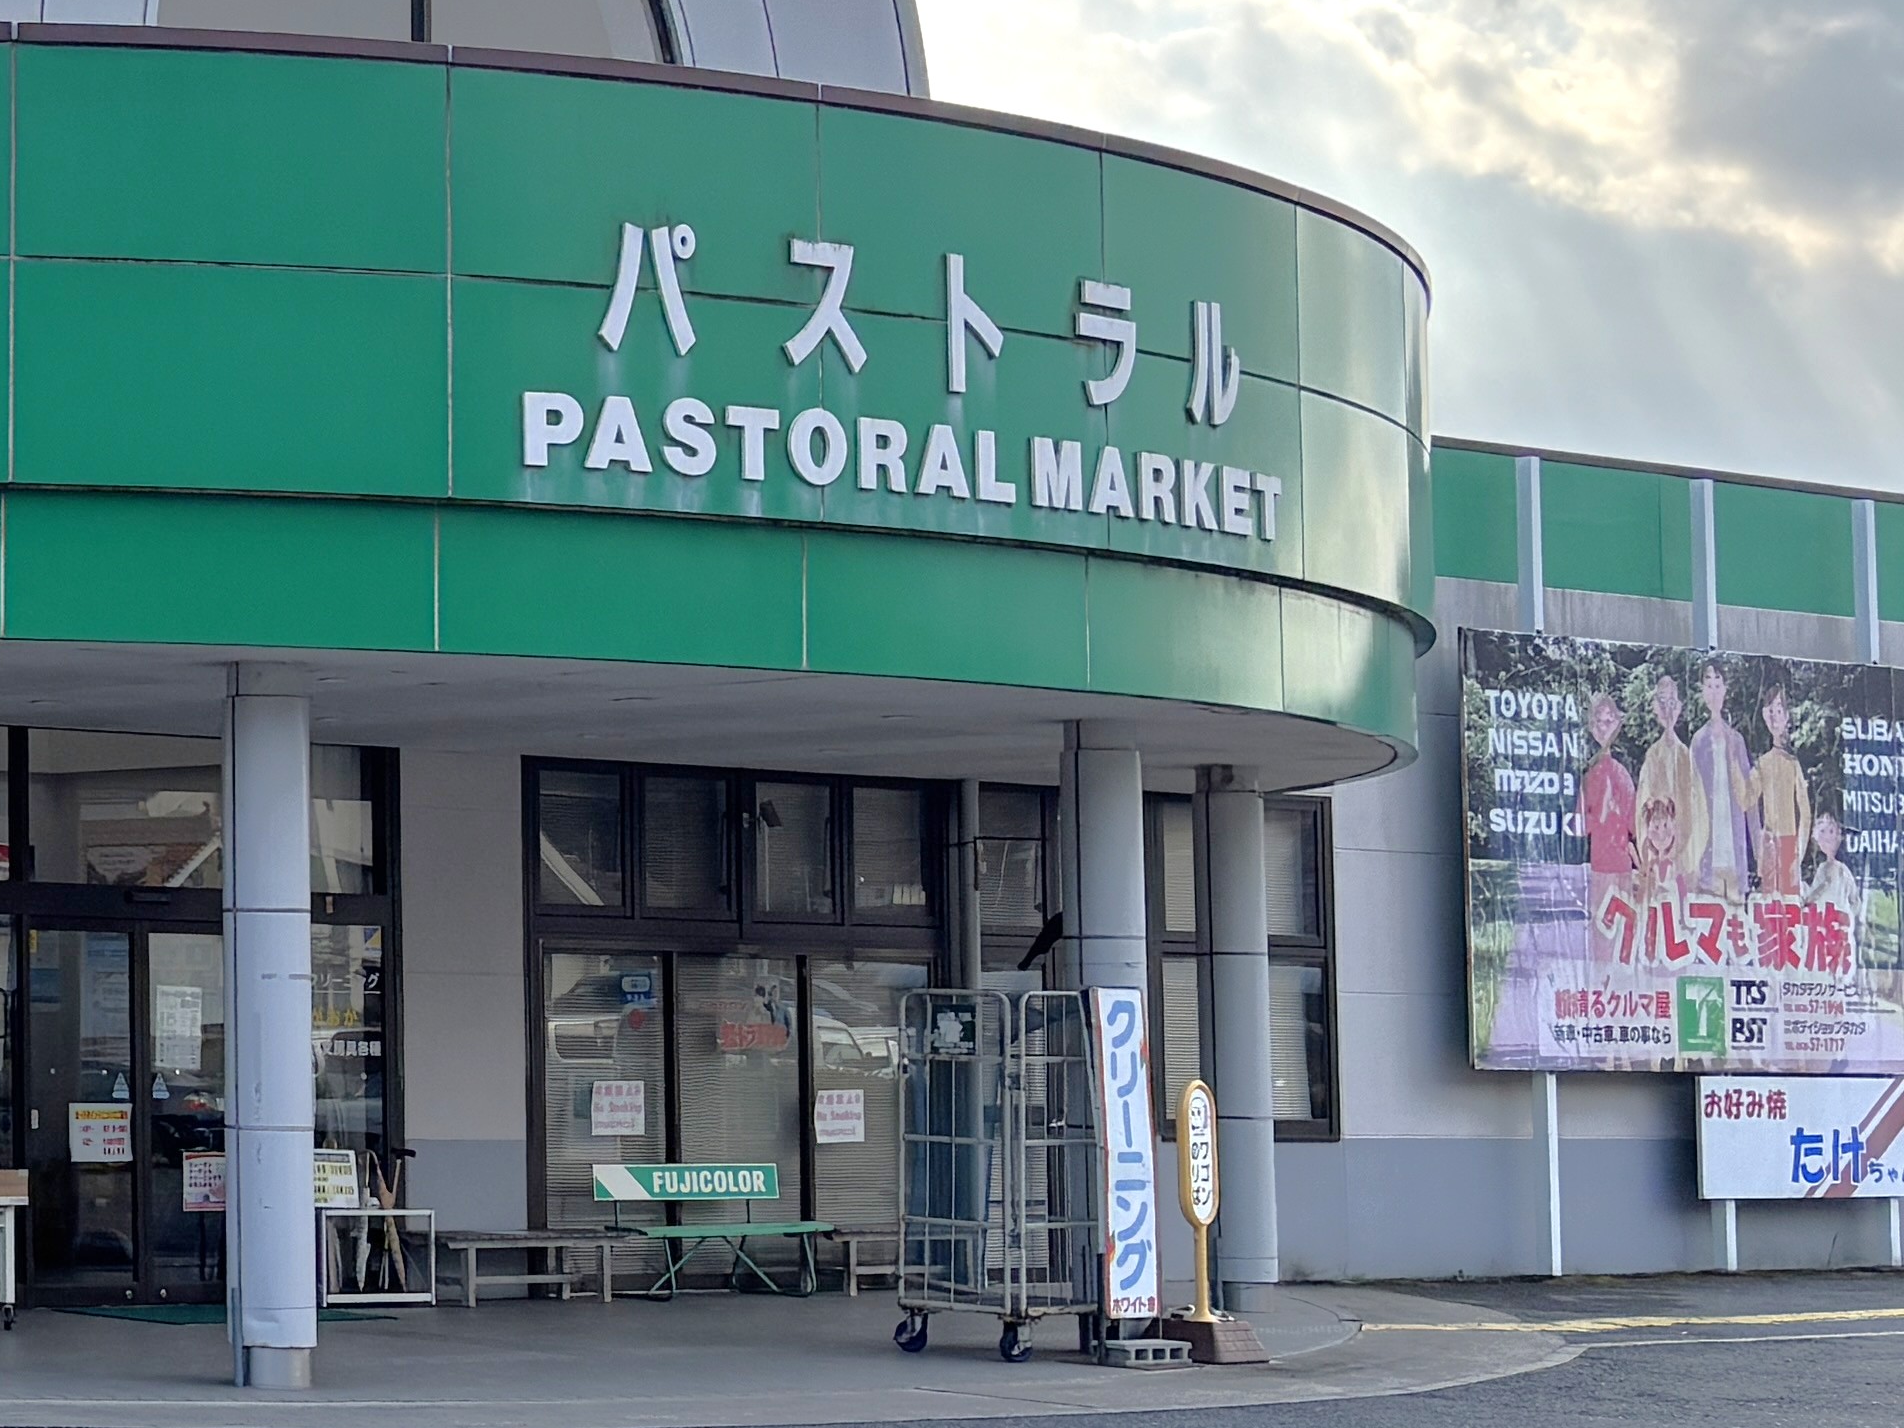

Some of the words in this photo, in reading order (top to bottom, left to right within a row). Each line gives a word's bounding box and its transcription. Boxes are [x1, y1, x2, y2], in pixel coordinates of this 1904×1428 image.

[597, 222, 1240, 426] パストラル
[522, 390, 1016, 504] PASTORAL
[1030, 435, 1282, 541] MARKET
[1486, 689, 1578, 721] TOYOTA
[1489, 728, 1579, 758] NISSAN
[1490, 808, 1583, 837] SUZUKI
[1601, 895, 1854, 974] クルマも家族
[1730, 980, 1769, 1005] TTS
[1732, 1018, 1768, 1043] BST
[1704, 1088, 1787, 1120] お好み焼
[1105, 1000, 1152, 1290] クリーニング
[1790, 1126, 1904, 1184] たけちゃ
[652, 1170, 766, 1194] FUJICOLOR
